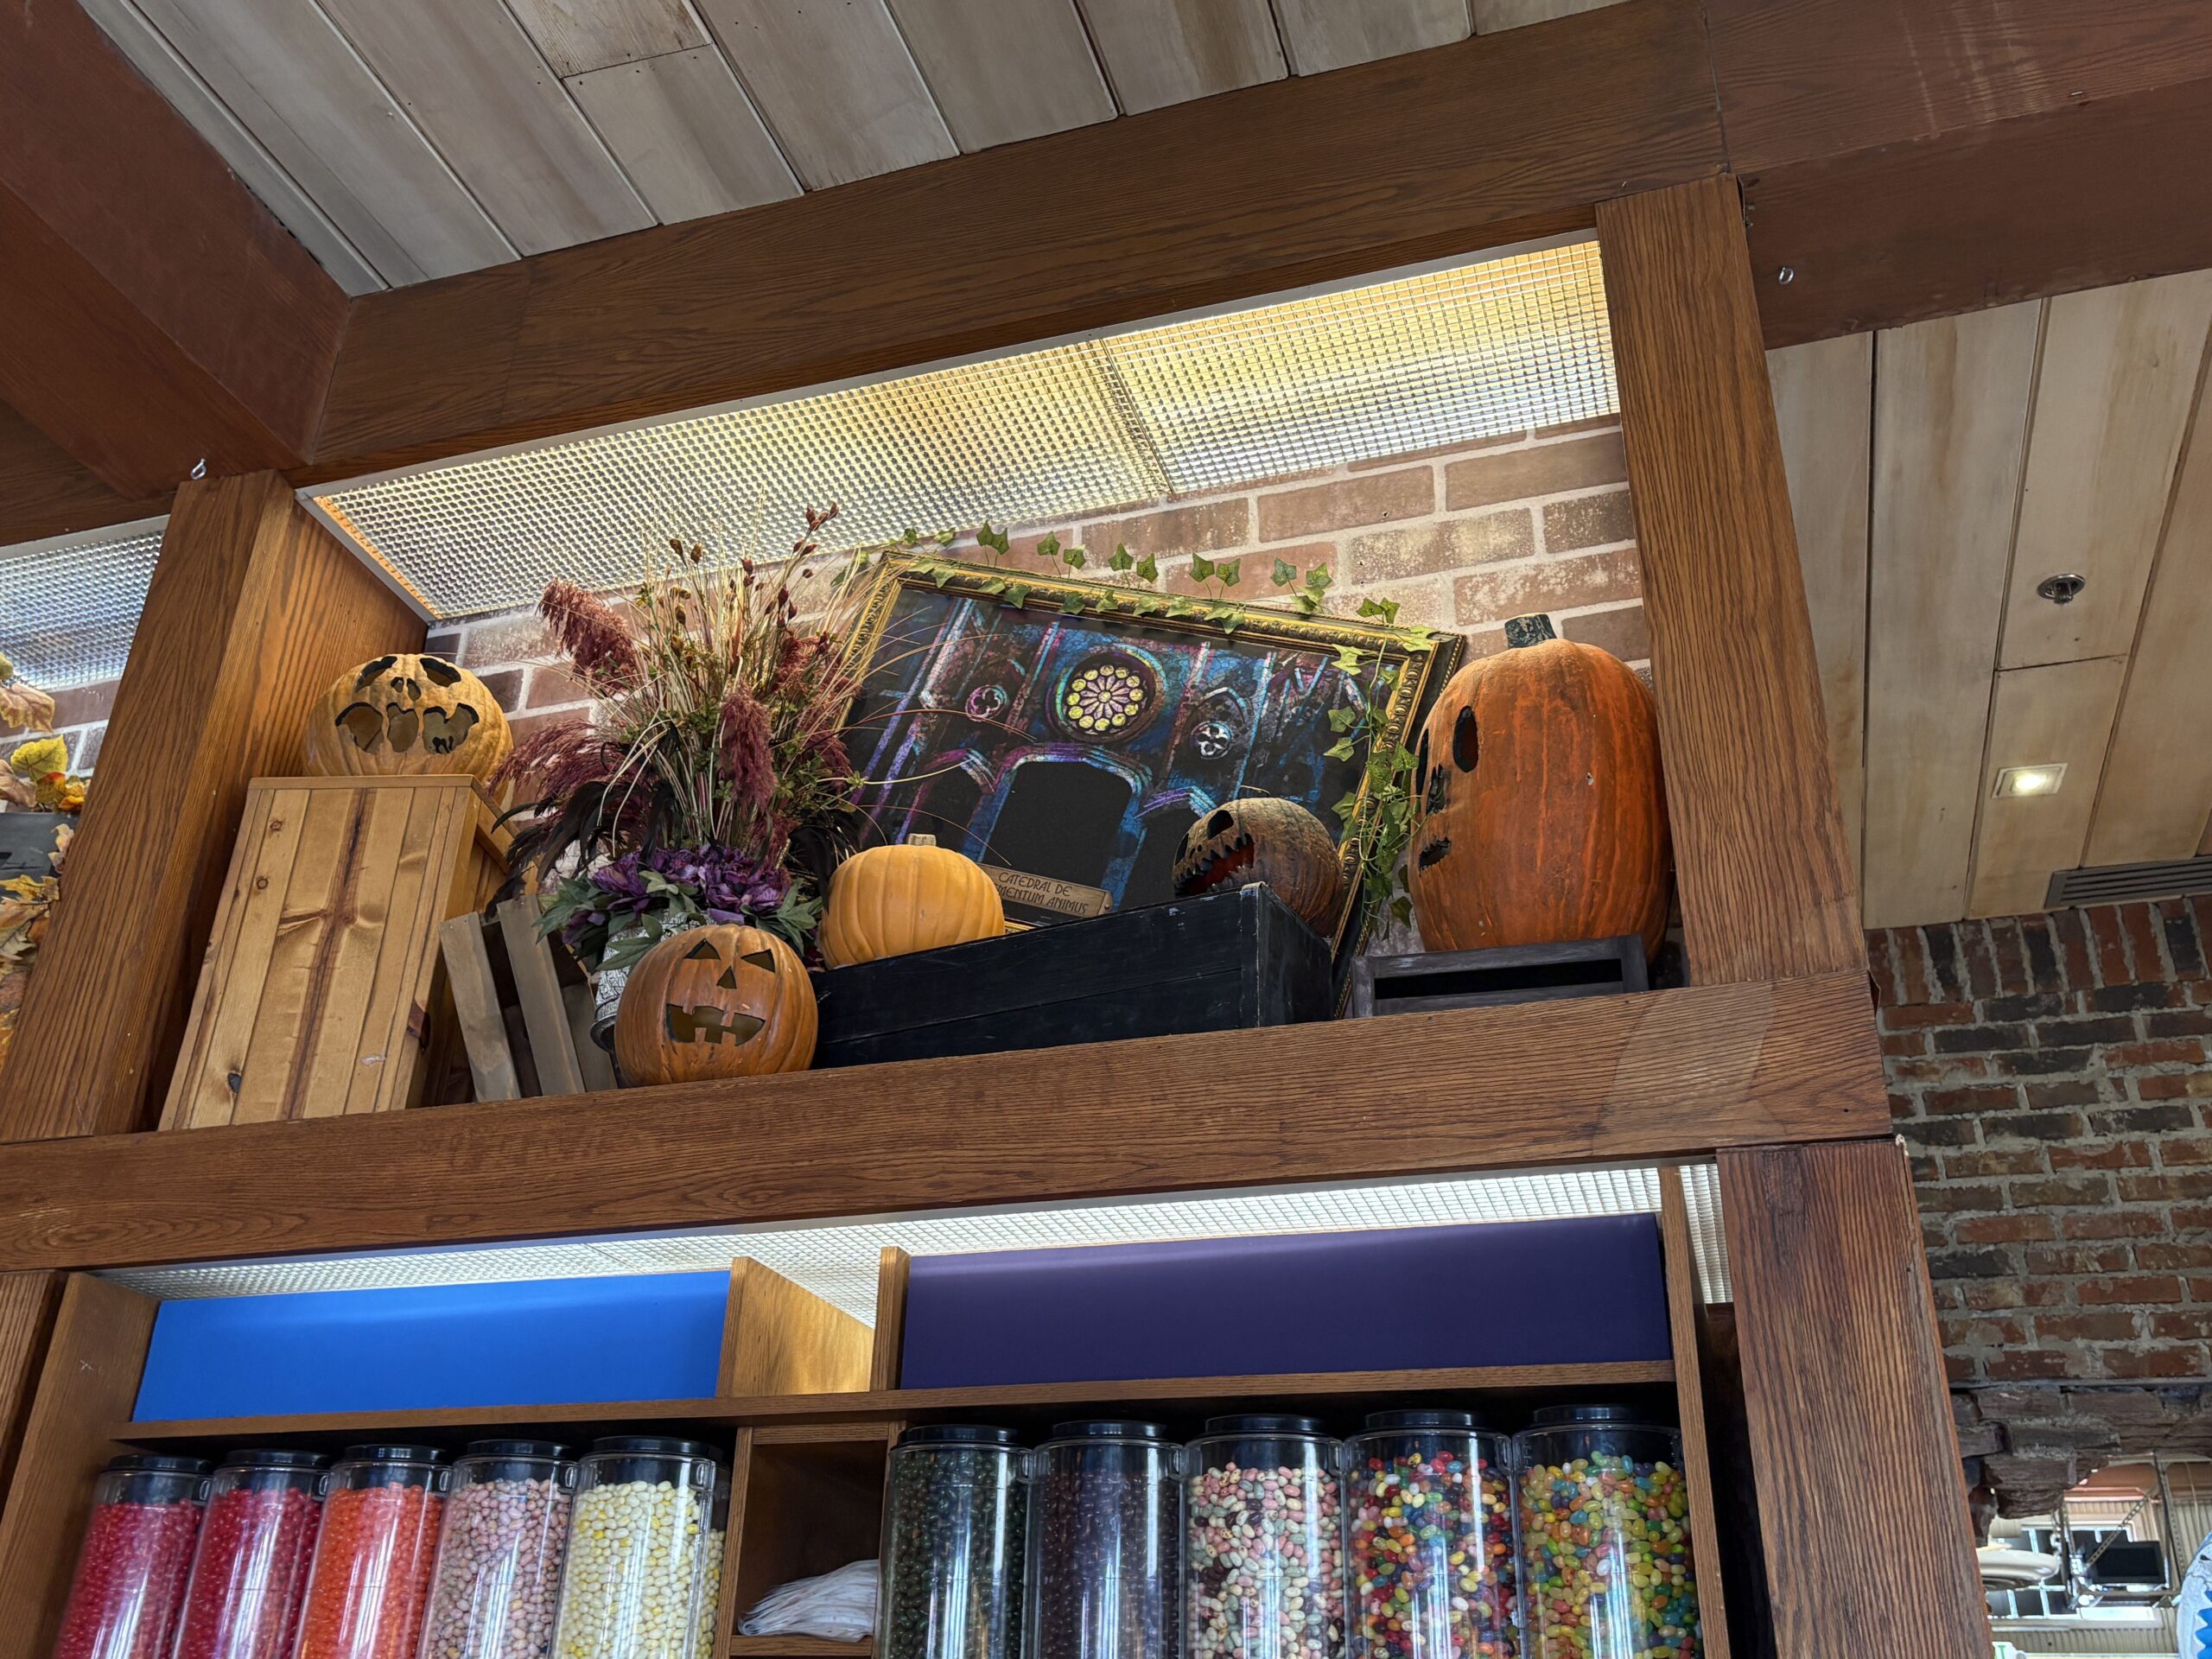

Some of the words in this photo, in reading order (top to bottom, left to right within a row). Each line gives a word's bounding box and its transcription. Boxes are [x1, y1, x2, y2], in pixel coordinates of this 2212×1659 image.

[998, 872, 1052, 893] CATEDRAL
[1054, 883, 1073, 896] DE
[994, 883, 1046, 905] MENTUM
[1046, 897, 1089, 913] ANIMUS
